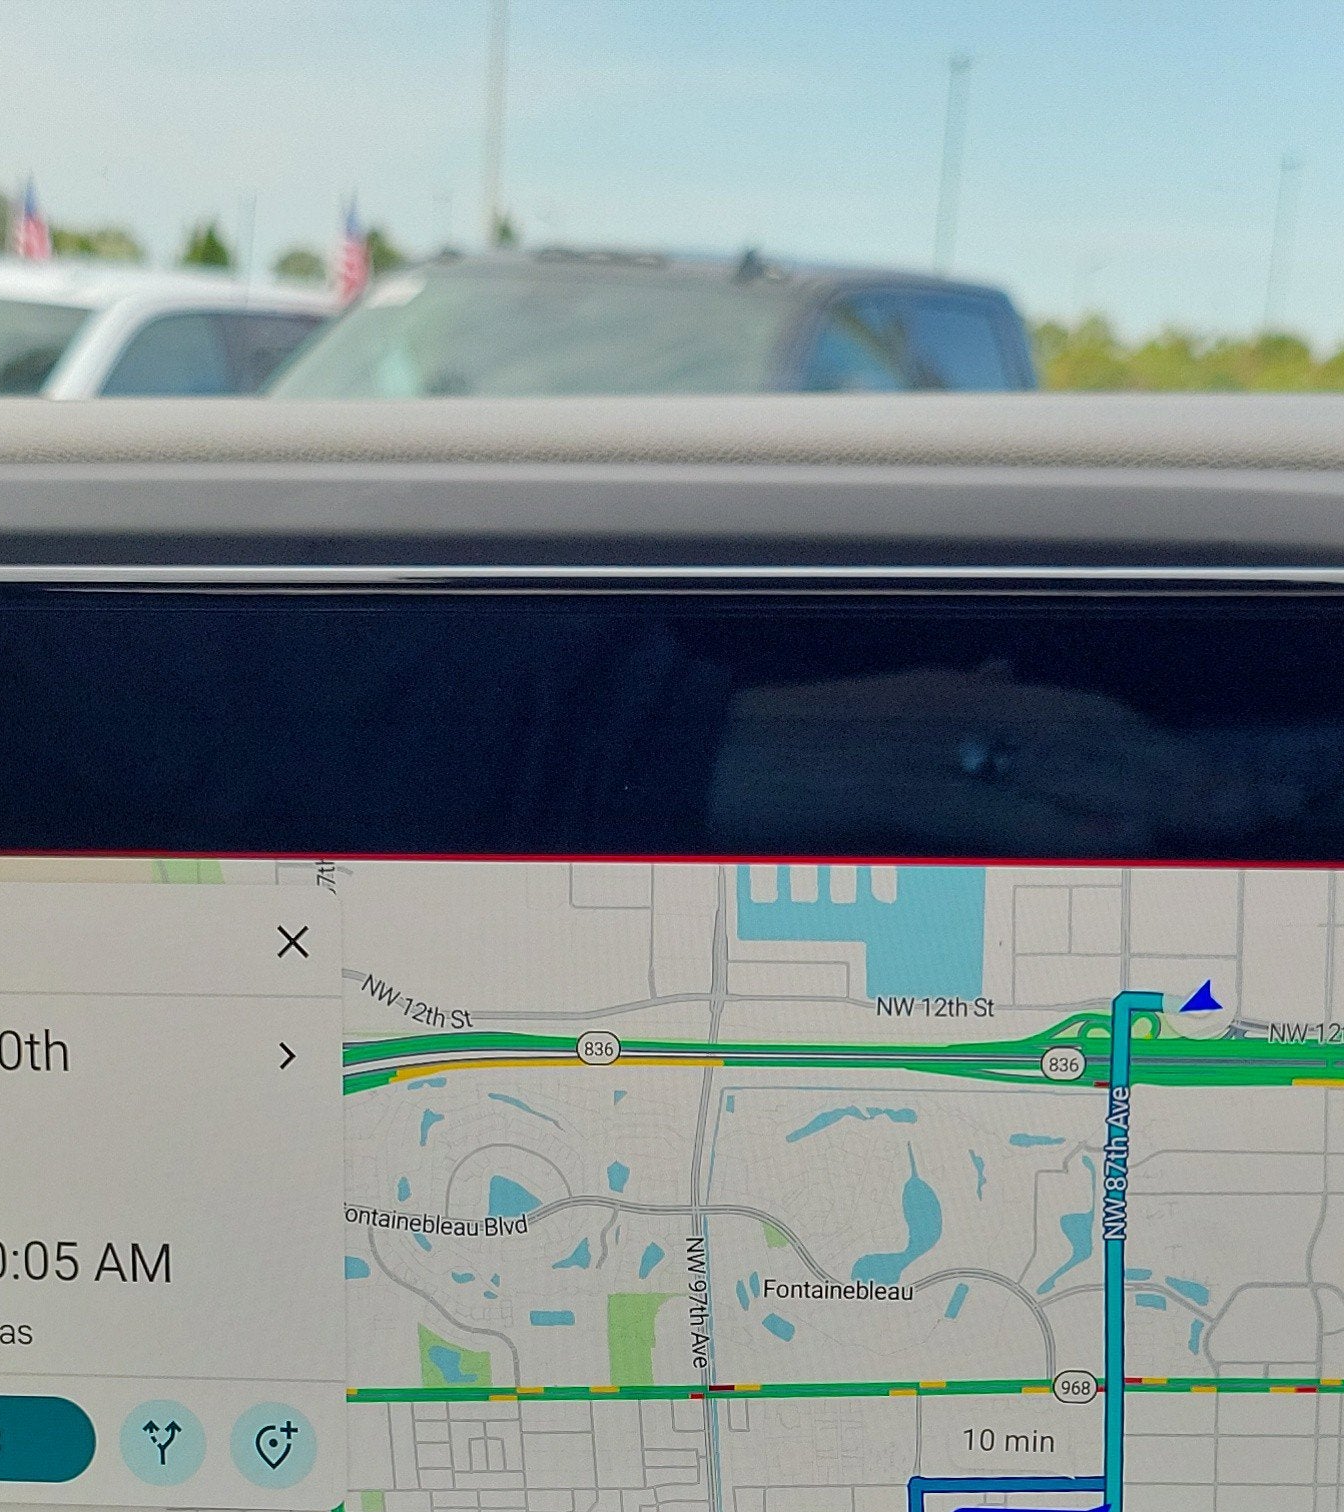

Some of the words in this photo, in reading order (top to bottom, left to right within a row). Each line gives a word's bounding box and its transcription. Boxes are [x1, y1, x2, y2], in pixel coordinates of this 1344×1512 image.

[361, 974, 401, 1006] NW
[404, 998, 445, 1028] 12th
[451, 1009, 473, 1029] St
[876, 998, 916, 1017] NW
[922, 998, 968, 1018] 12th
[973, 998, 995, 1018] St
[584, 1041, 614, 1057] 836
[1268, 1022, 1307, 1042] NW
[1049, 1057, 1079, 1073] 836
[1106, 1086, 1130, 1130] Ave
[1105, 1136, 1128, 1191] 87th
[344, 1202, 479, 1237] ontainebleau
[485, 1214, 529, 1237] Blvd
[1105, 1198, 1126, 1240] NW
[94, 1242, 173, 1283] AM
[686, 1237, 706, 1274] NW
[688, 1280, 709, 1326] 97th
[763, 1279, 914, 1301] Fontainebleau
[691, 1332, 710, 1368] Ave
[1061, 1380, 1091, 1396] 968
[963, 1428, 996, 1453] 10
[1005, 1430, 1056, 1454] min
